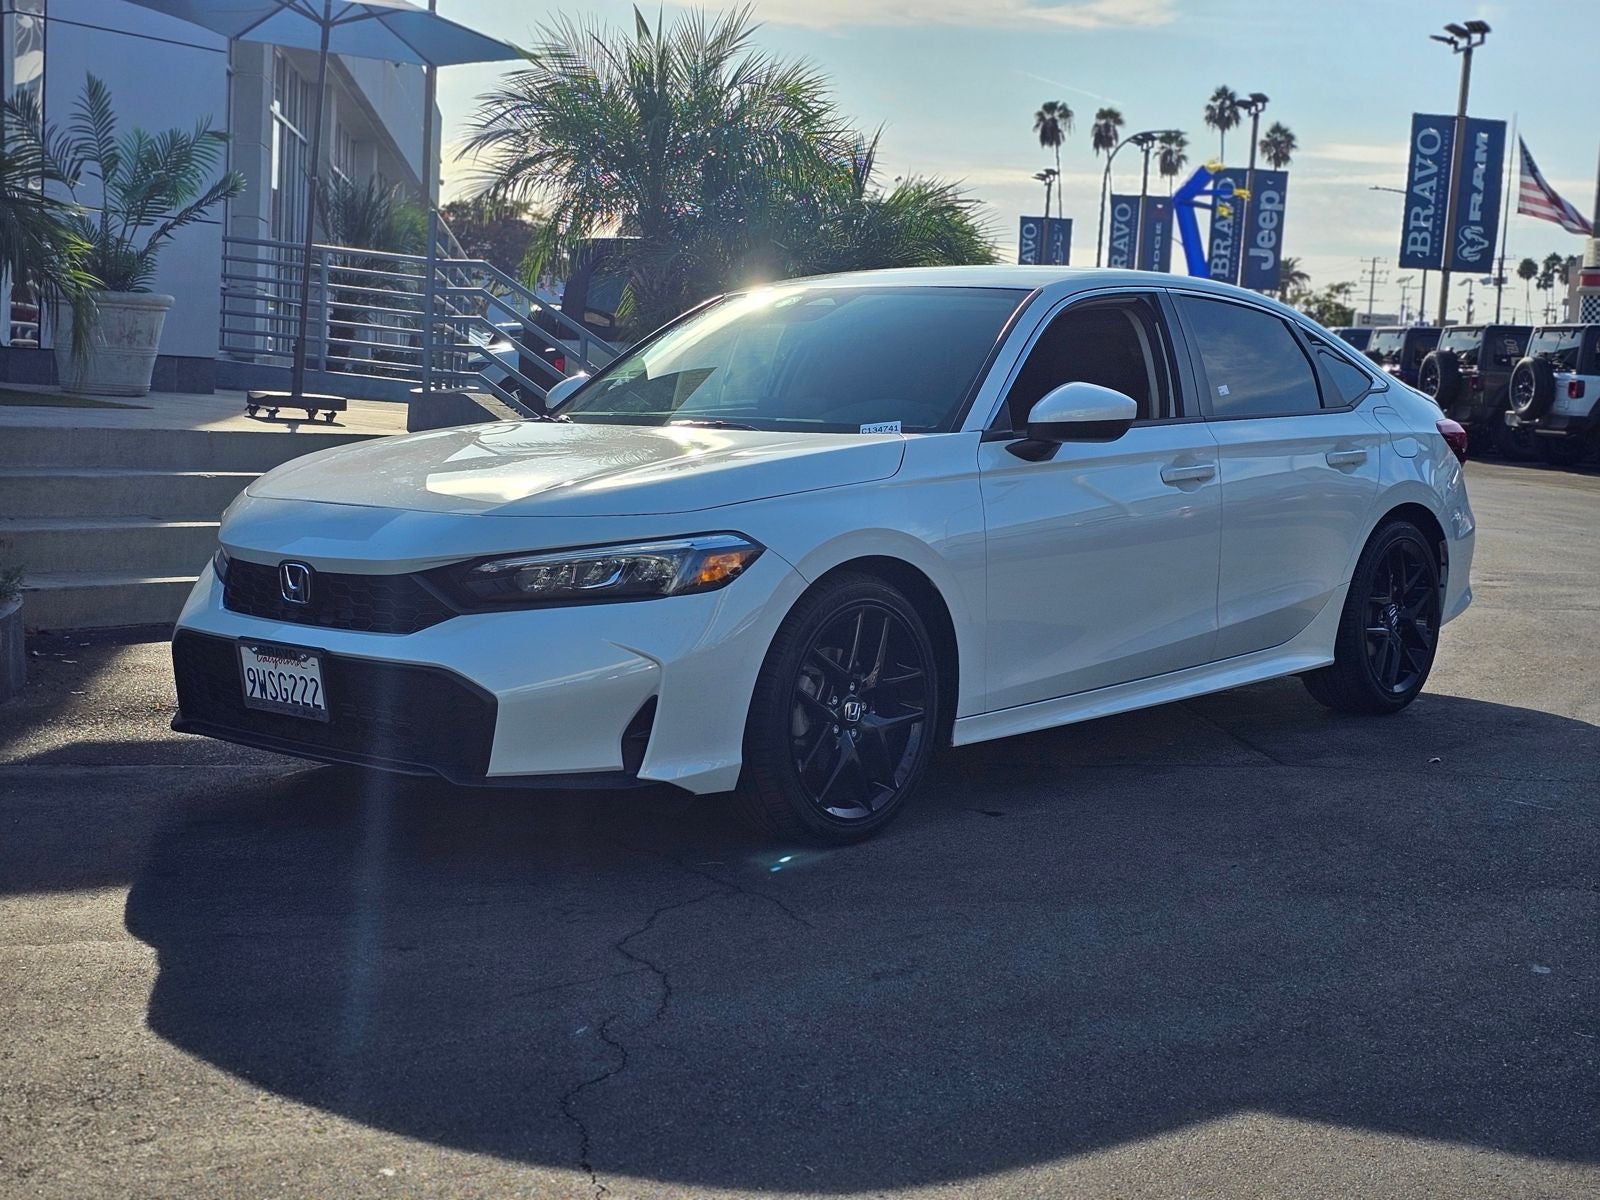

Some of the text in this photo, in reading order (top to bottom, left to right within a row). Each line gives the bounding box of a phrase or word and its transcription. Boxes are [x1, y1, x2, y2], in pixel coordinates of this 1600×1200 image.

[1406, 127, 1441, 257] BRAVO
[1468, 132, 1489, 221] RAM
[1021, 223, 1037, 265] AVO
[1111, 203, 1132, 269] RAVO
[1153, 221, 1163, 272] ODGE
[1248, 190, 1283, 271] Jeep
[247, 667, 322, 709] 9WSG222
